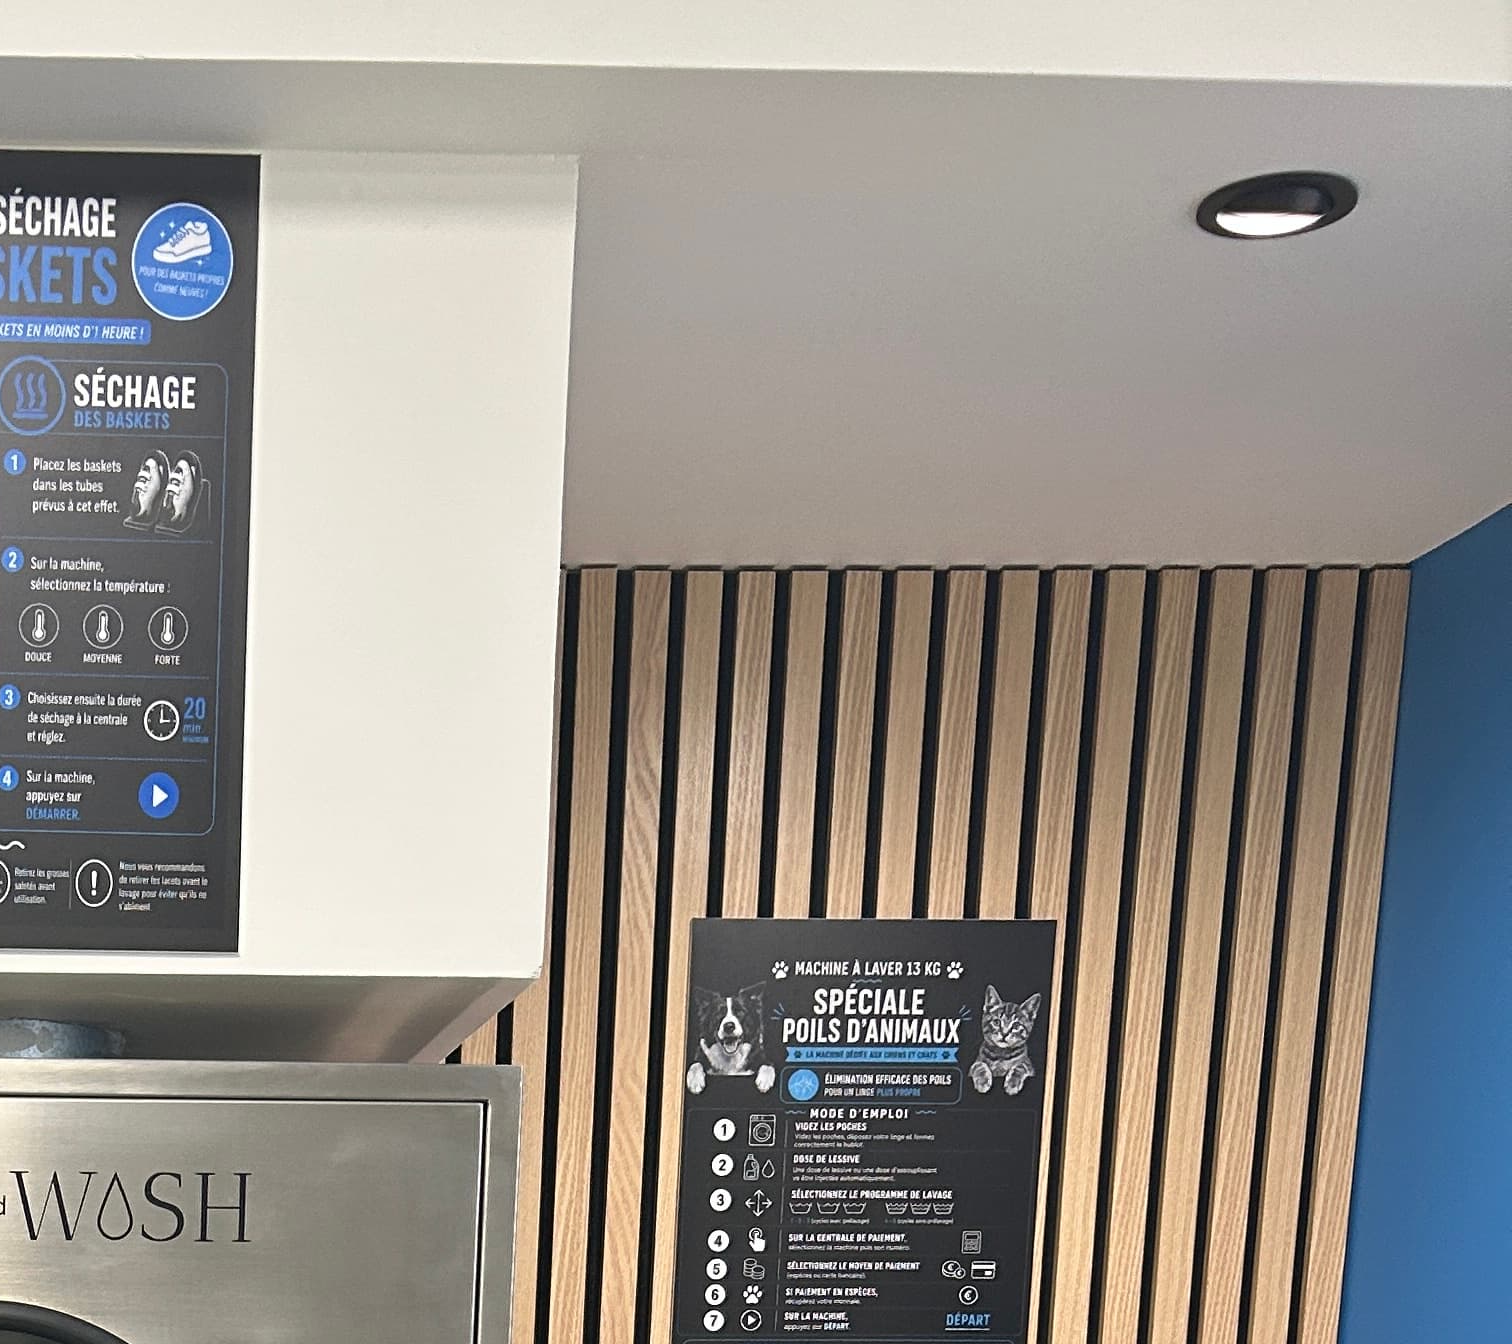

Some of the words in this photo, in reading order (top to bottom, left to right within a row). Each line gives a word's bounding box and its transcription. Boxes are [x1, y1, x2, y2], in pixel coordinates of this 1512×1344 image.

[27, 324, 41, 336] EN
[44, 324, 80, 337] MOINS
[83, 326, 98, 338] D'1
[102, 326, 137, 339] HEURE
[74, 367, 195, 409] SÉCHAGE
[74, 411, 101, 427] DES
[106, 411, 169, 428] BASKETS
[11, 455, 17, 470] 1
[34, 457, 64, 471] Placez
[68, 459, 81, 471] les
[84, 459, 121, 472] baskets
[33, 478, 56, 490] dans
[60, 479, 73, 491] les
[76, 480, 103, 492] tubes
[9, 552, 16, 568] 2
[31, 557, 47, 569] Sur
[50, 557, 58, 569] la
[61, 558, 104, 572] machine,
[25, 652, 51, 662] DOUCE
[84, 654, 122, 663] MOYENNE
[155, 655, 180, 665] FORTE
[184, 697, 205, 719] 20
[795, 962, 849, 975] MACHINE
[852, 959, 860, 975] À
[865, 962, 902, 975] LAVER
[907, 962, 920, 976] 13
[925, 962, 940, 975] KG
[814, 983, 925, 1015] SPÉCIALE
[783, 1018, 840, 1042] POILS
[847, 1019, 960, 1043] D'ANIMAUX
[825, 1073, 873, 1084] ÉLIMINATION
[876, 1075, 910, 1084] EFFICACE
[913, 1075, 927, 1084] DES
[929, 1075, 951, 1084] POILS
[810, 1108, 844, 1118] MODE
[850, 1109, 907, 1119] D'EMPLOI
[722, 1124, 726, 1136] 1
[719, 1159, 726, 1171] 2
[717, 1194, 724, 1206] 3
[714, 1235, 722, 1247] 4
[713, 1263, 720, 1275] 5
[712, 1289, 718, 1300] 6
[711, 1315, 717, 1326] 7
[947, 1312, 990, 1325] DÉPART
